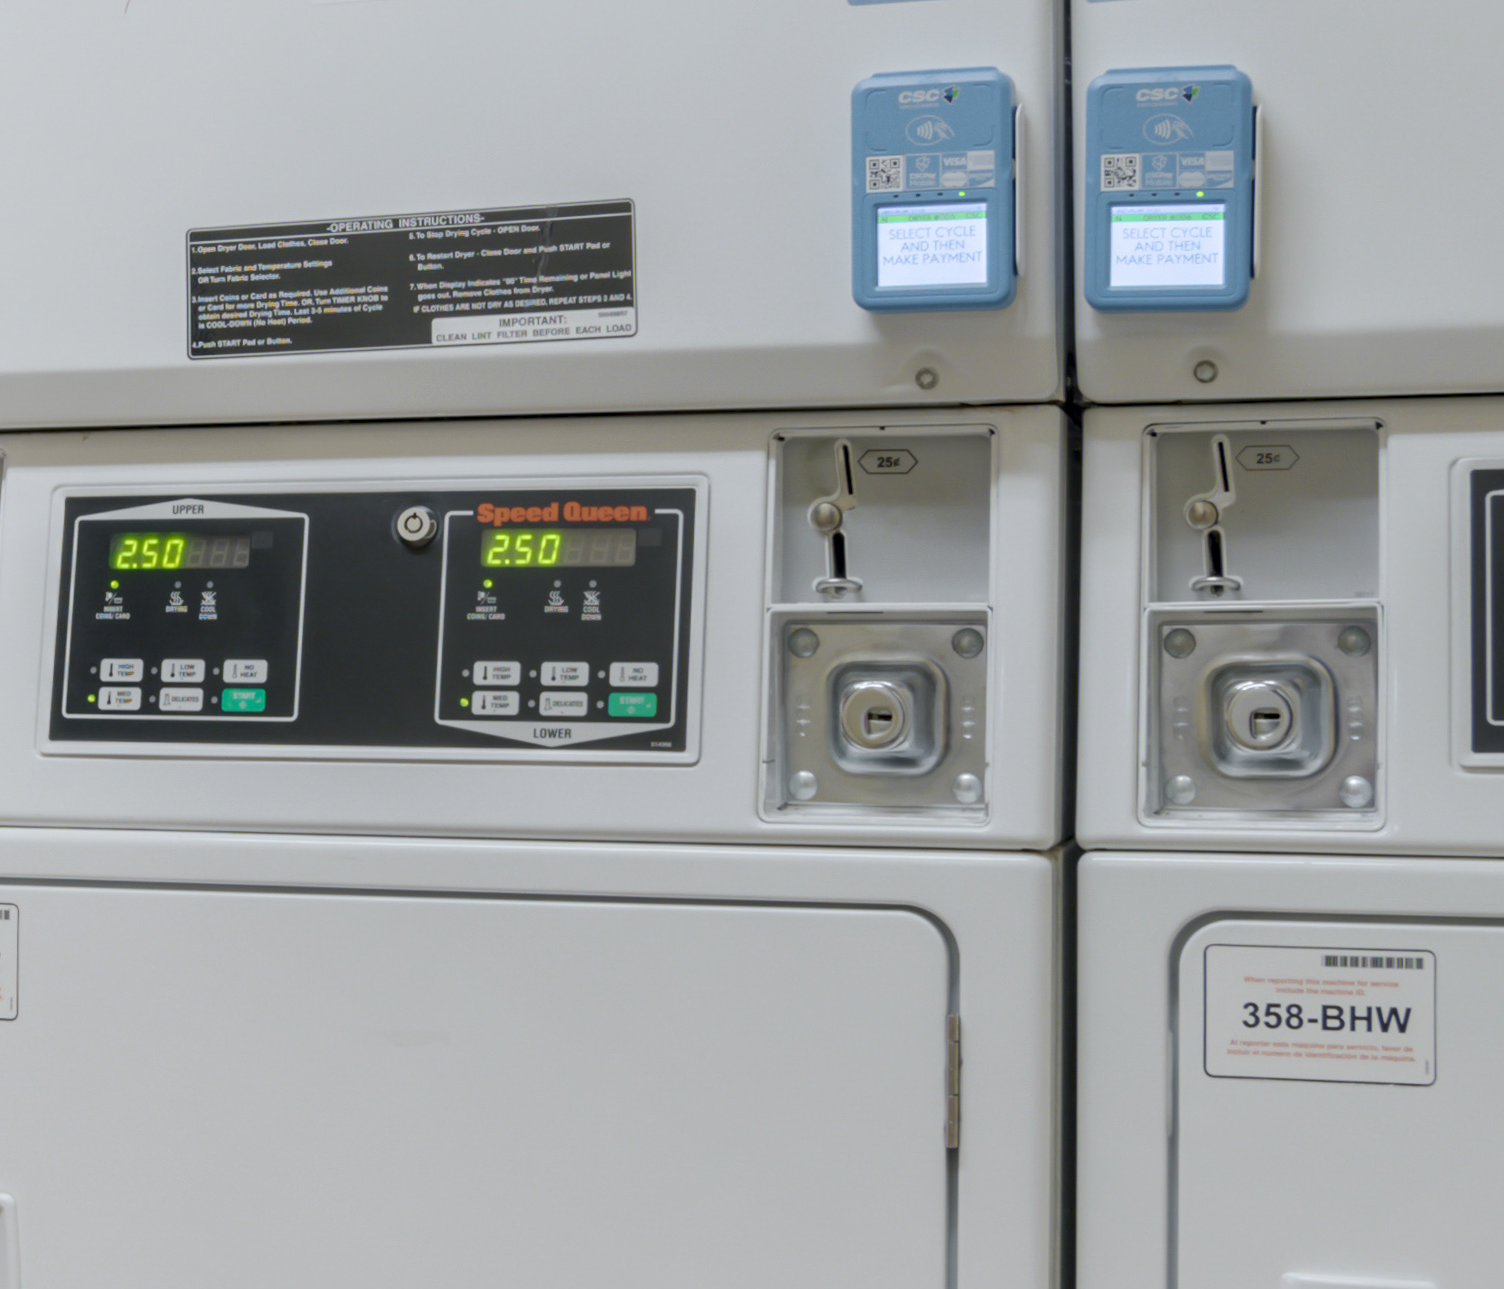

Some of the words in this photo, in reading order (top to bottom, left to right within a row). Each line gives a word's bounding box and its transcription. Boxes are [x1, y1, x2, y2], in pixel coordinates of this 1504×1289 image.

[899, 89, 940, 103] CSC
[1136, 87, 1179, 101] CSC
[889, 227, 931, 240] SELECT
[935, 225, 976, 237] CYCLE
[1122, 227, 1166, 239] SELECT
[1170, 226, 1212, 238] CYCLE
[900, 241, 929, 252] AND
[934, 240, 965, 250] THEN
[1134, 241, 1164, 252] AND
[1169, 240, 1201, 250] THEN
[883, 254, 919, 266] MAKE
[922, 251, 982, 264] PAYMENT
[1116, 254, 1152, 265] MAKE
[1157, 253, 1219, 264] PAYMENT
[499, 315, 567, 327] IMPORTANT:
[436, 334, 467, 342] CLEAN
[472, 332, 492, 340] LINT
[497, 330, 527, 339] FILTER
[533, 328, 570, 337] BEFORE
[576, 326, 601, 334] EACH
[606, 324, 632, 332] LOAD
[877, 457, 900, 468] 25¢
[1256, 453, 1280, 464] 25¢
[172, 505, 204, 514] UPPER
[477, 501, 559, 526] Speed
[563, 501, 648, 523] Queen
[116, 538, 185, 569] 2.50
[486, 534, 561, 565] 2.50
[533, 728, 572, 739] LOWER
[1242, 1002, 1412, 1033] 358-BHW
